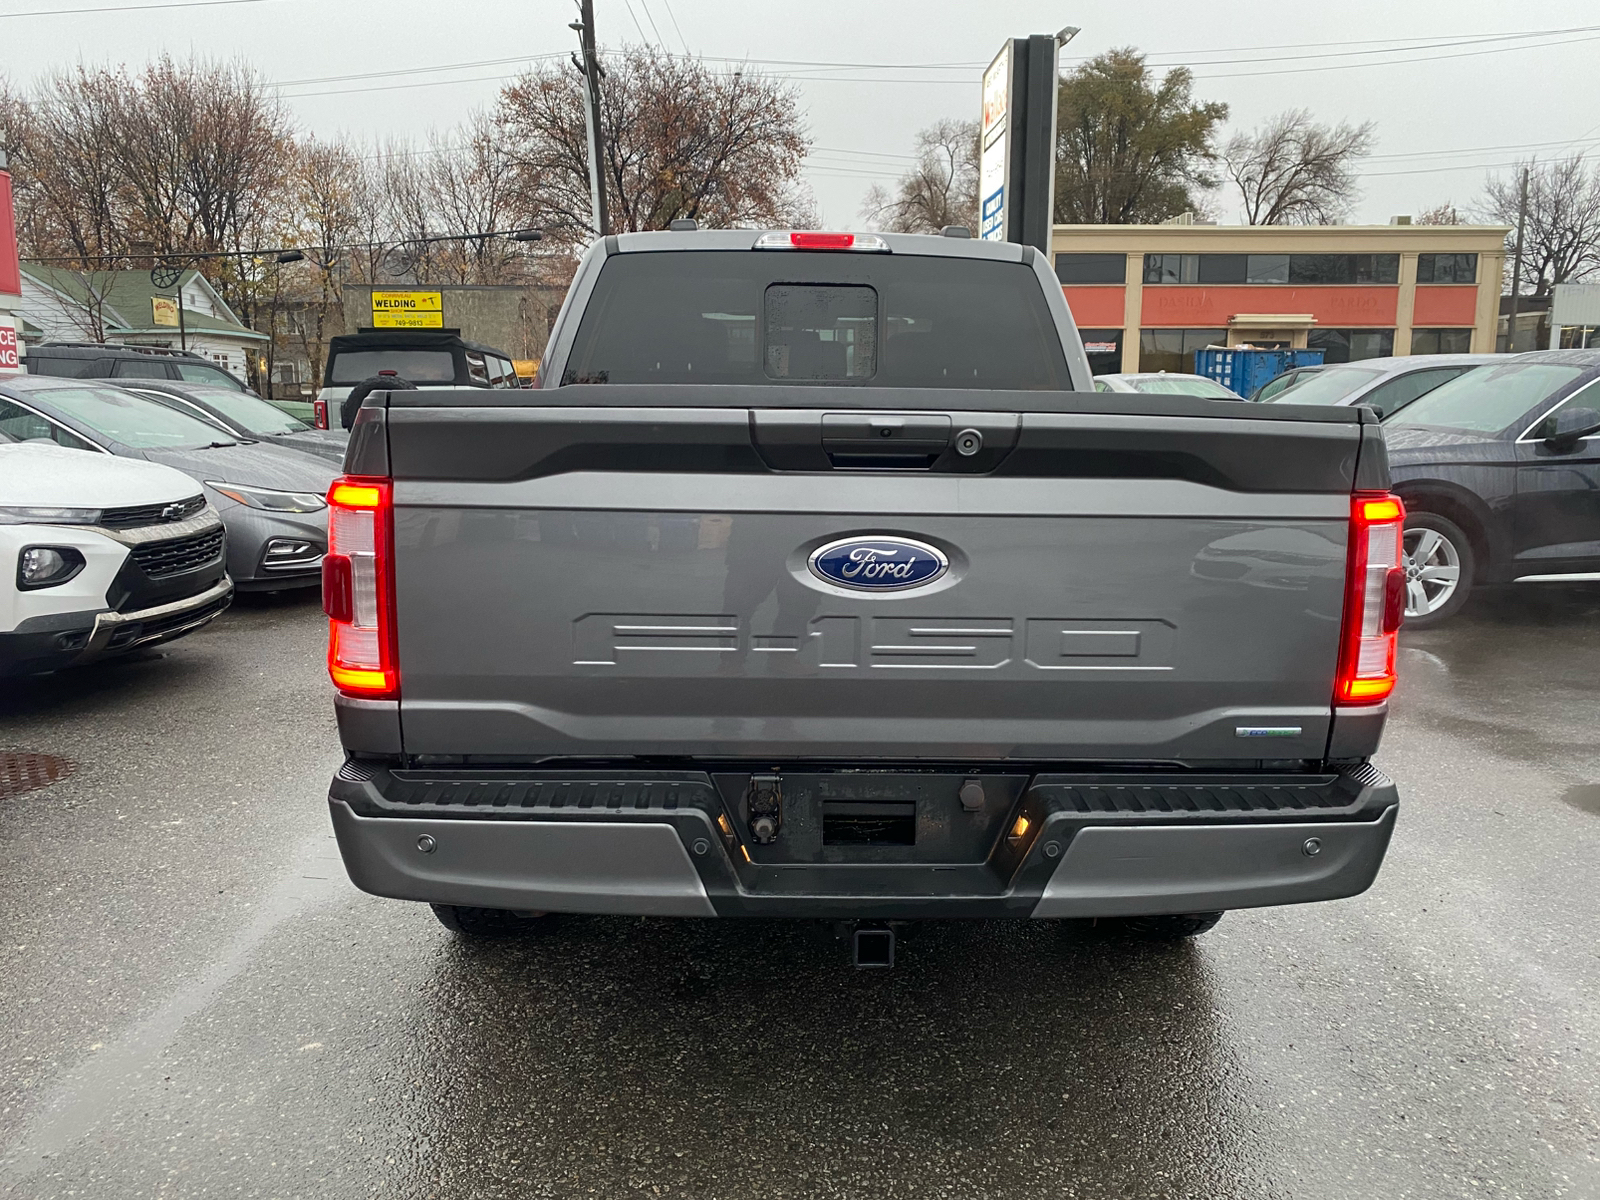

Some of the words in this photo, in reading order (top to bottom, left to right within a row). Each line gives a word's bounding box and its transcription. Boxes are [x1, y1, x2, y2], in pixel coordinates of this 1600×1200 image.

[982, 215, 994, 234] USED
[375, 299, 416, 308] WELDING
[842, 547, 916, 578] Ford
[572, 613, 1178, 670] F-150
